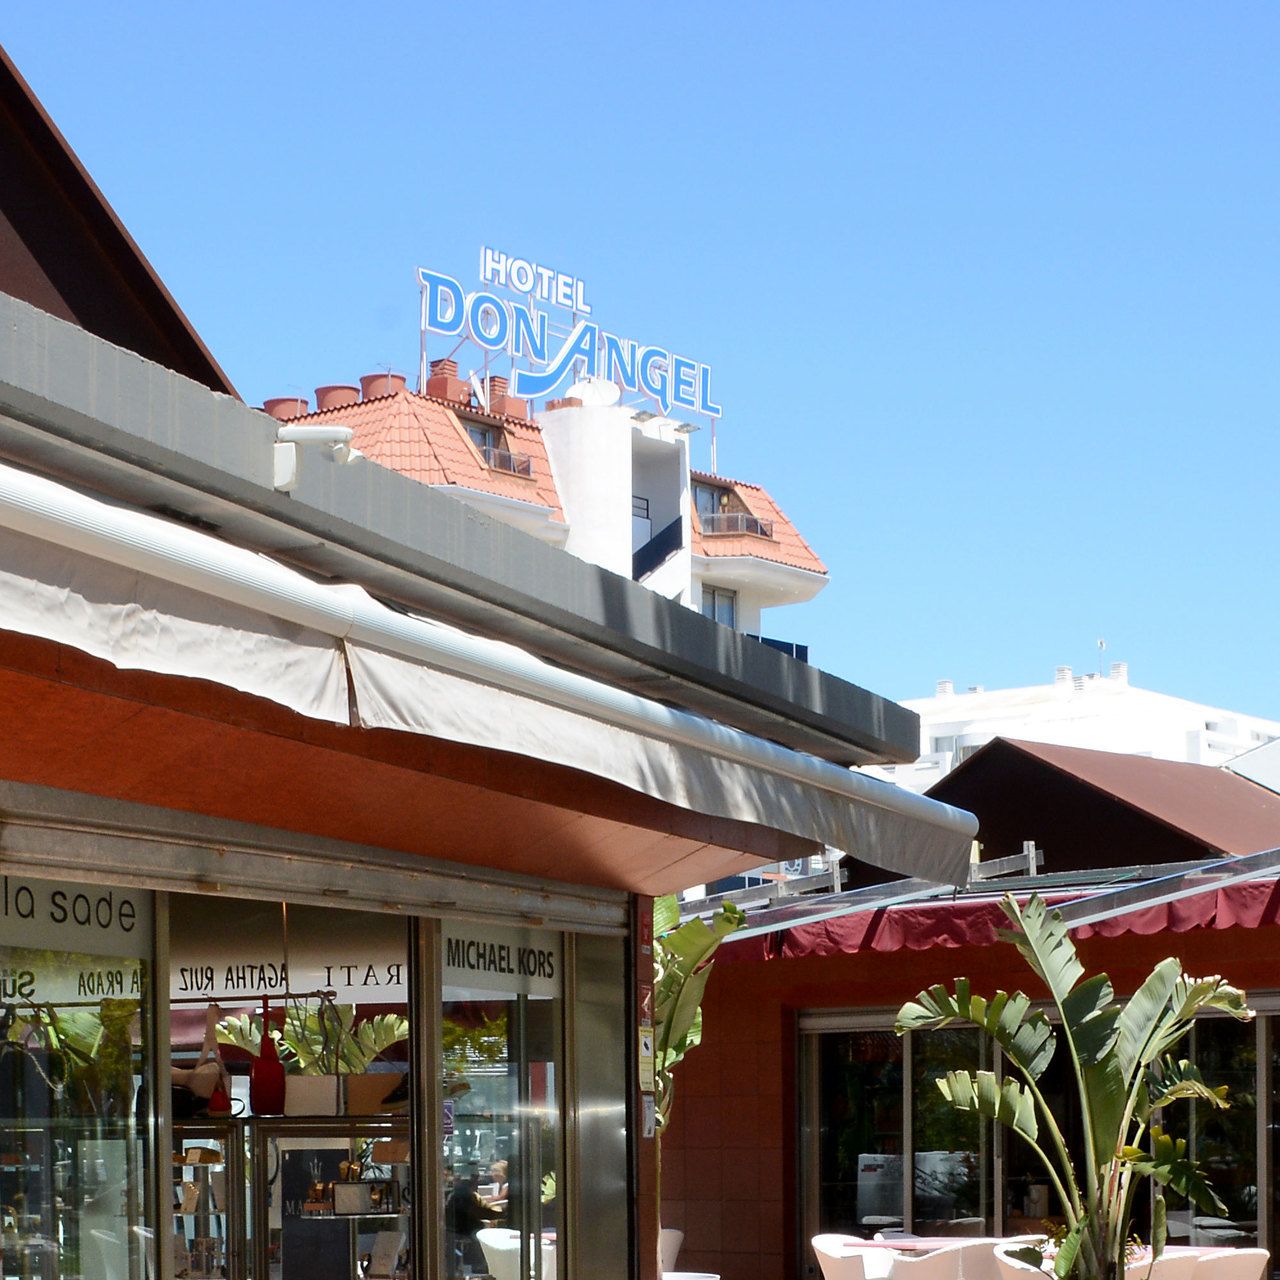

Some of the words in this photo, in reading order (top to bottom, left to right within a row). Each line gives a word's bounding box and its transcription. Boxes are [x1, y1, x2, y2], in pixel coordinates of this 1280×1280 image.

[481, 246, 591, 315] HOTEL
[418, 266, 549, 365] DON
[515, 319, 722, 418] ANGEL
[50, 890, 137, 932] sade
[447, 938, 514, 974] MICHAEL
[518, 947, 555, 978] KORS
